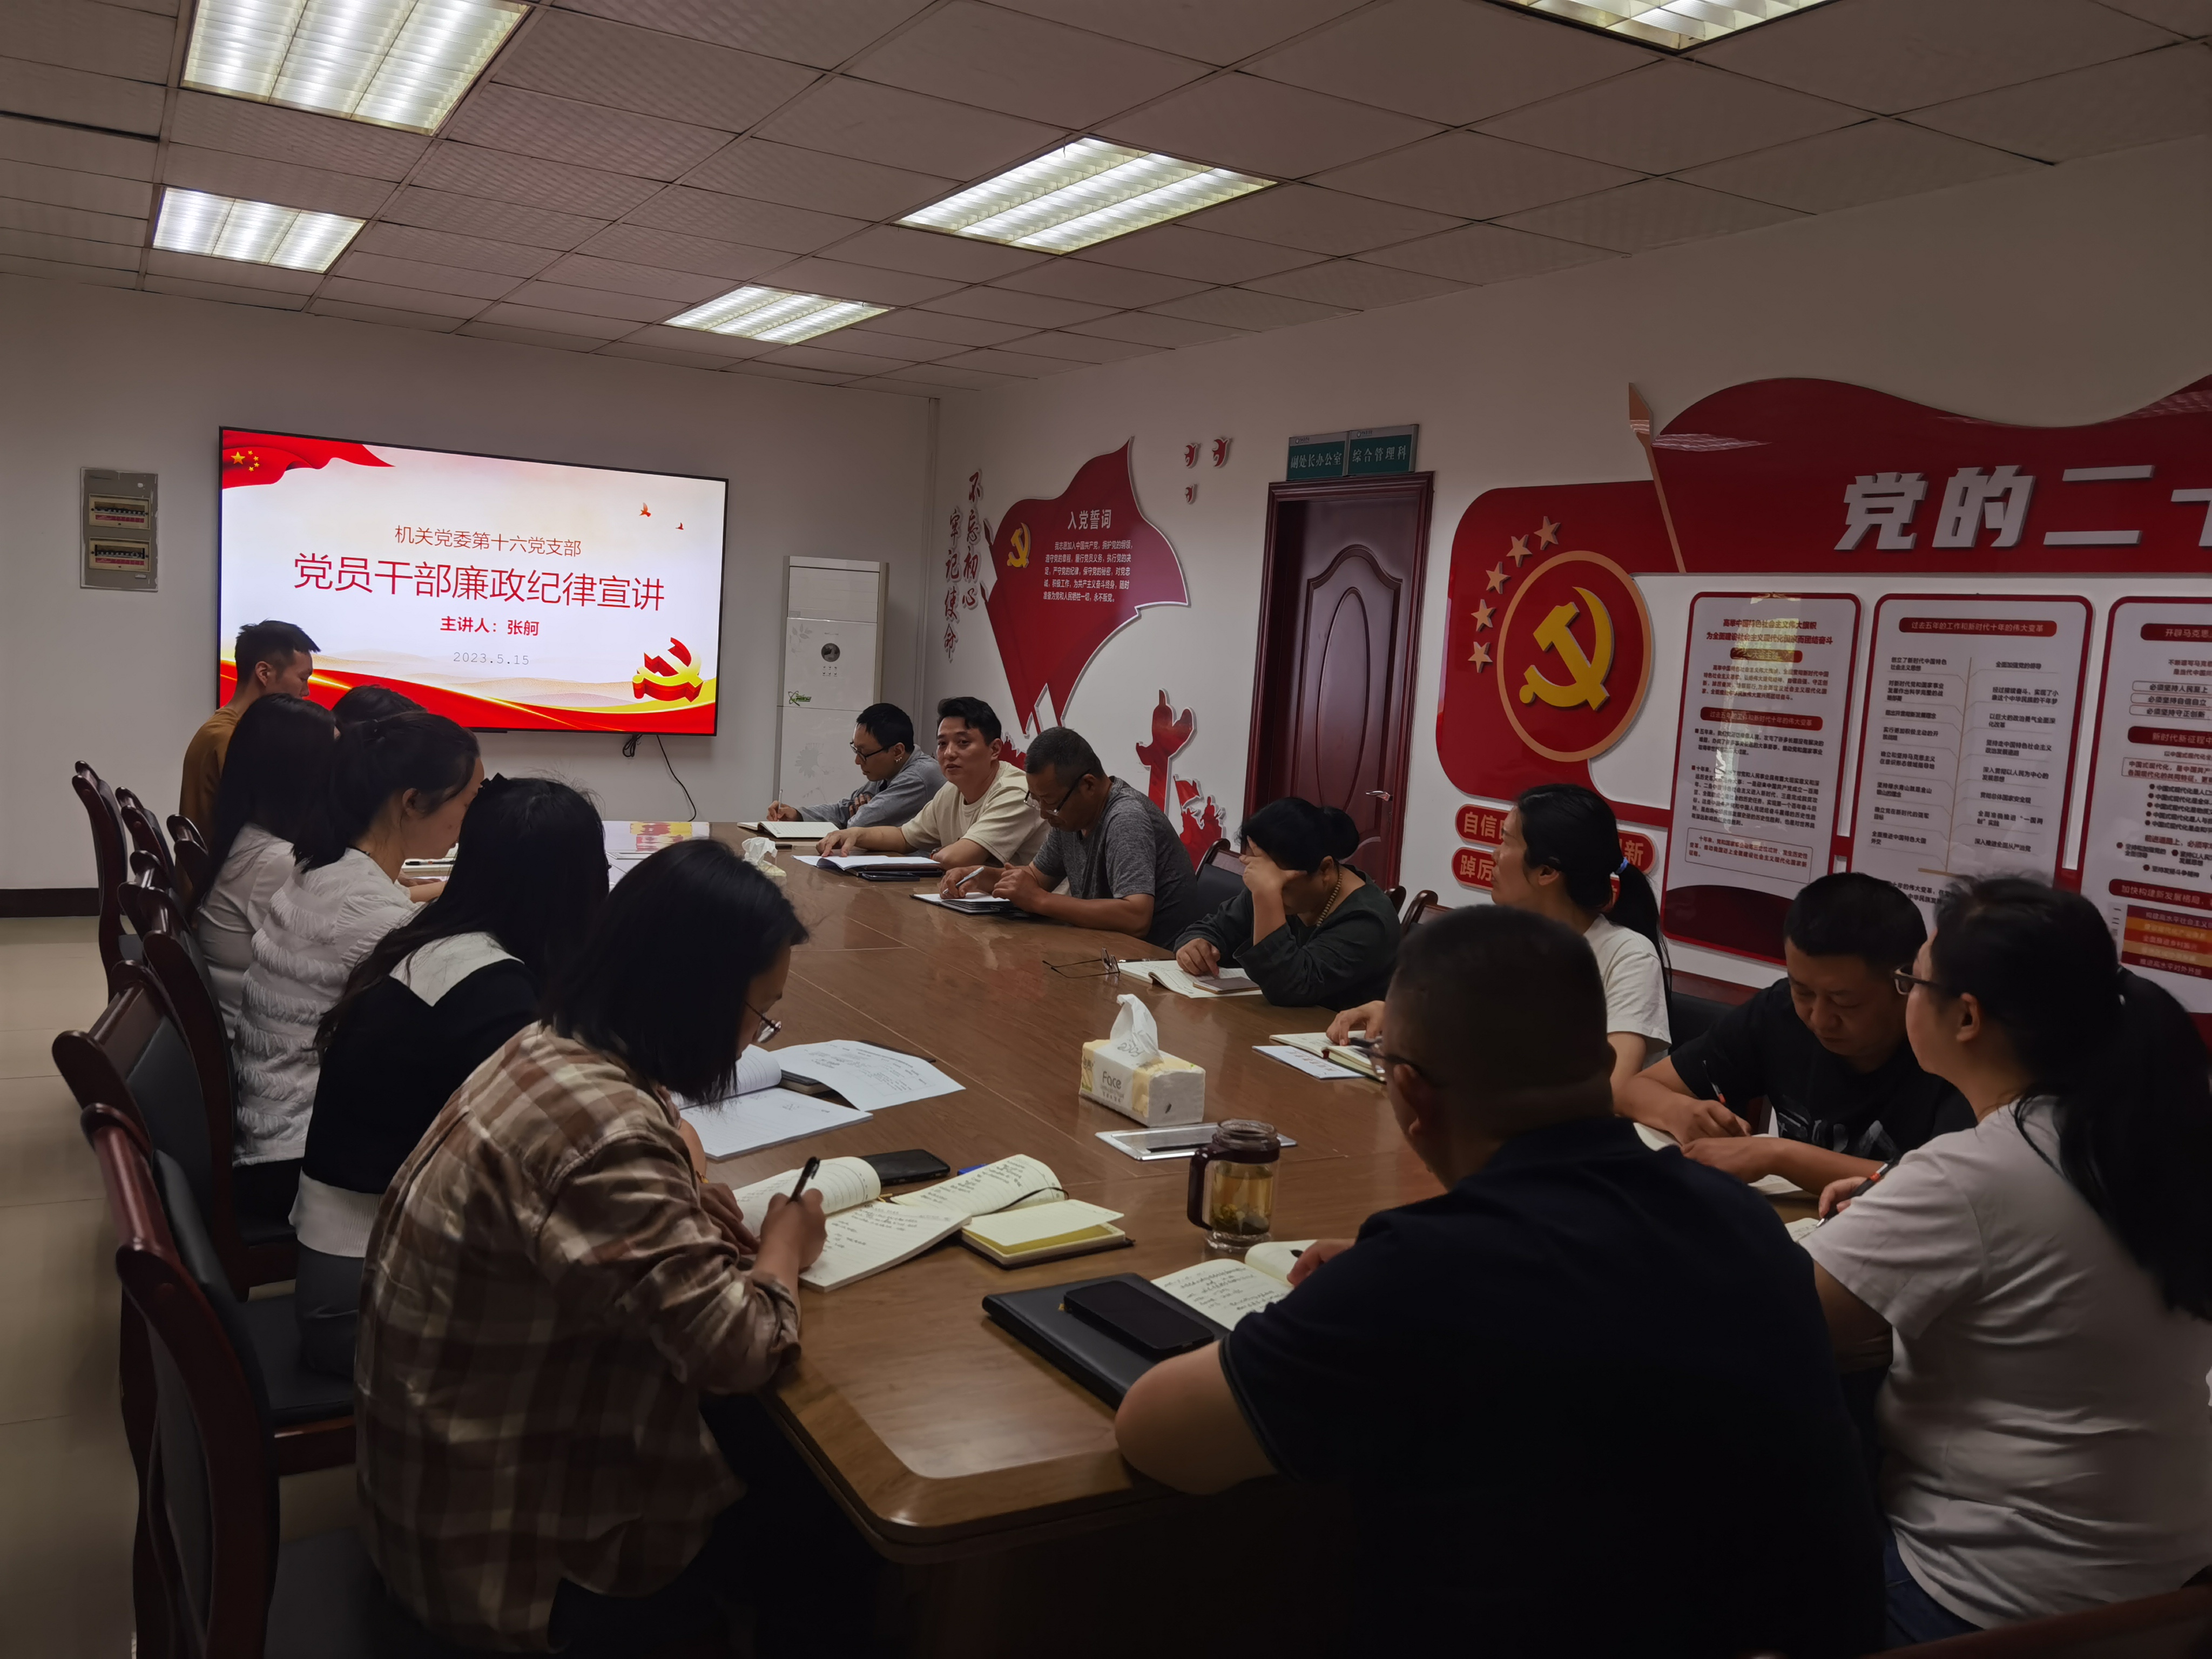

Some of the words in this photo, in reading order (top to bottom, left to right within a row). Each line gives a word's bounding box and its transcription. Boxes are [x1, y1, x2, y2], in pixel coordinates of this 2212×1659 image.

[1290, 451, 1342, 469] 副处长办公室
[1352, 445, 1406, 463] 综合管理科
[1068, 509, 1111, 530] 入党誓词
[395, 525, 582, 557] 机关党委第十六党支部
[962, 471, 980, 606] 不忘初心
[293, 552, 664, 611] 党员干部廉政纪律宣讲
[944, 508, 960, 659] 牢记使命
[1911, 622, 2044, 633] 过去五年的工作和新时代十年的伟大变革
[2165, 629, 2212, 639] 开辟马克思
[453, 652, 529, 665] 2023.5.15
[2155, 794, 2212, 805] 中国式现代化是全体
[2156, 785, 2212, 796] 中国式现代化是人口
[2121, 885, 2212, 907] 加快构建新发展格局，
[1102, 1070, 1122, 1090] Face
